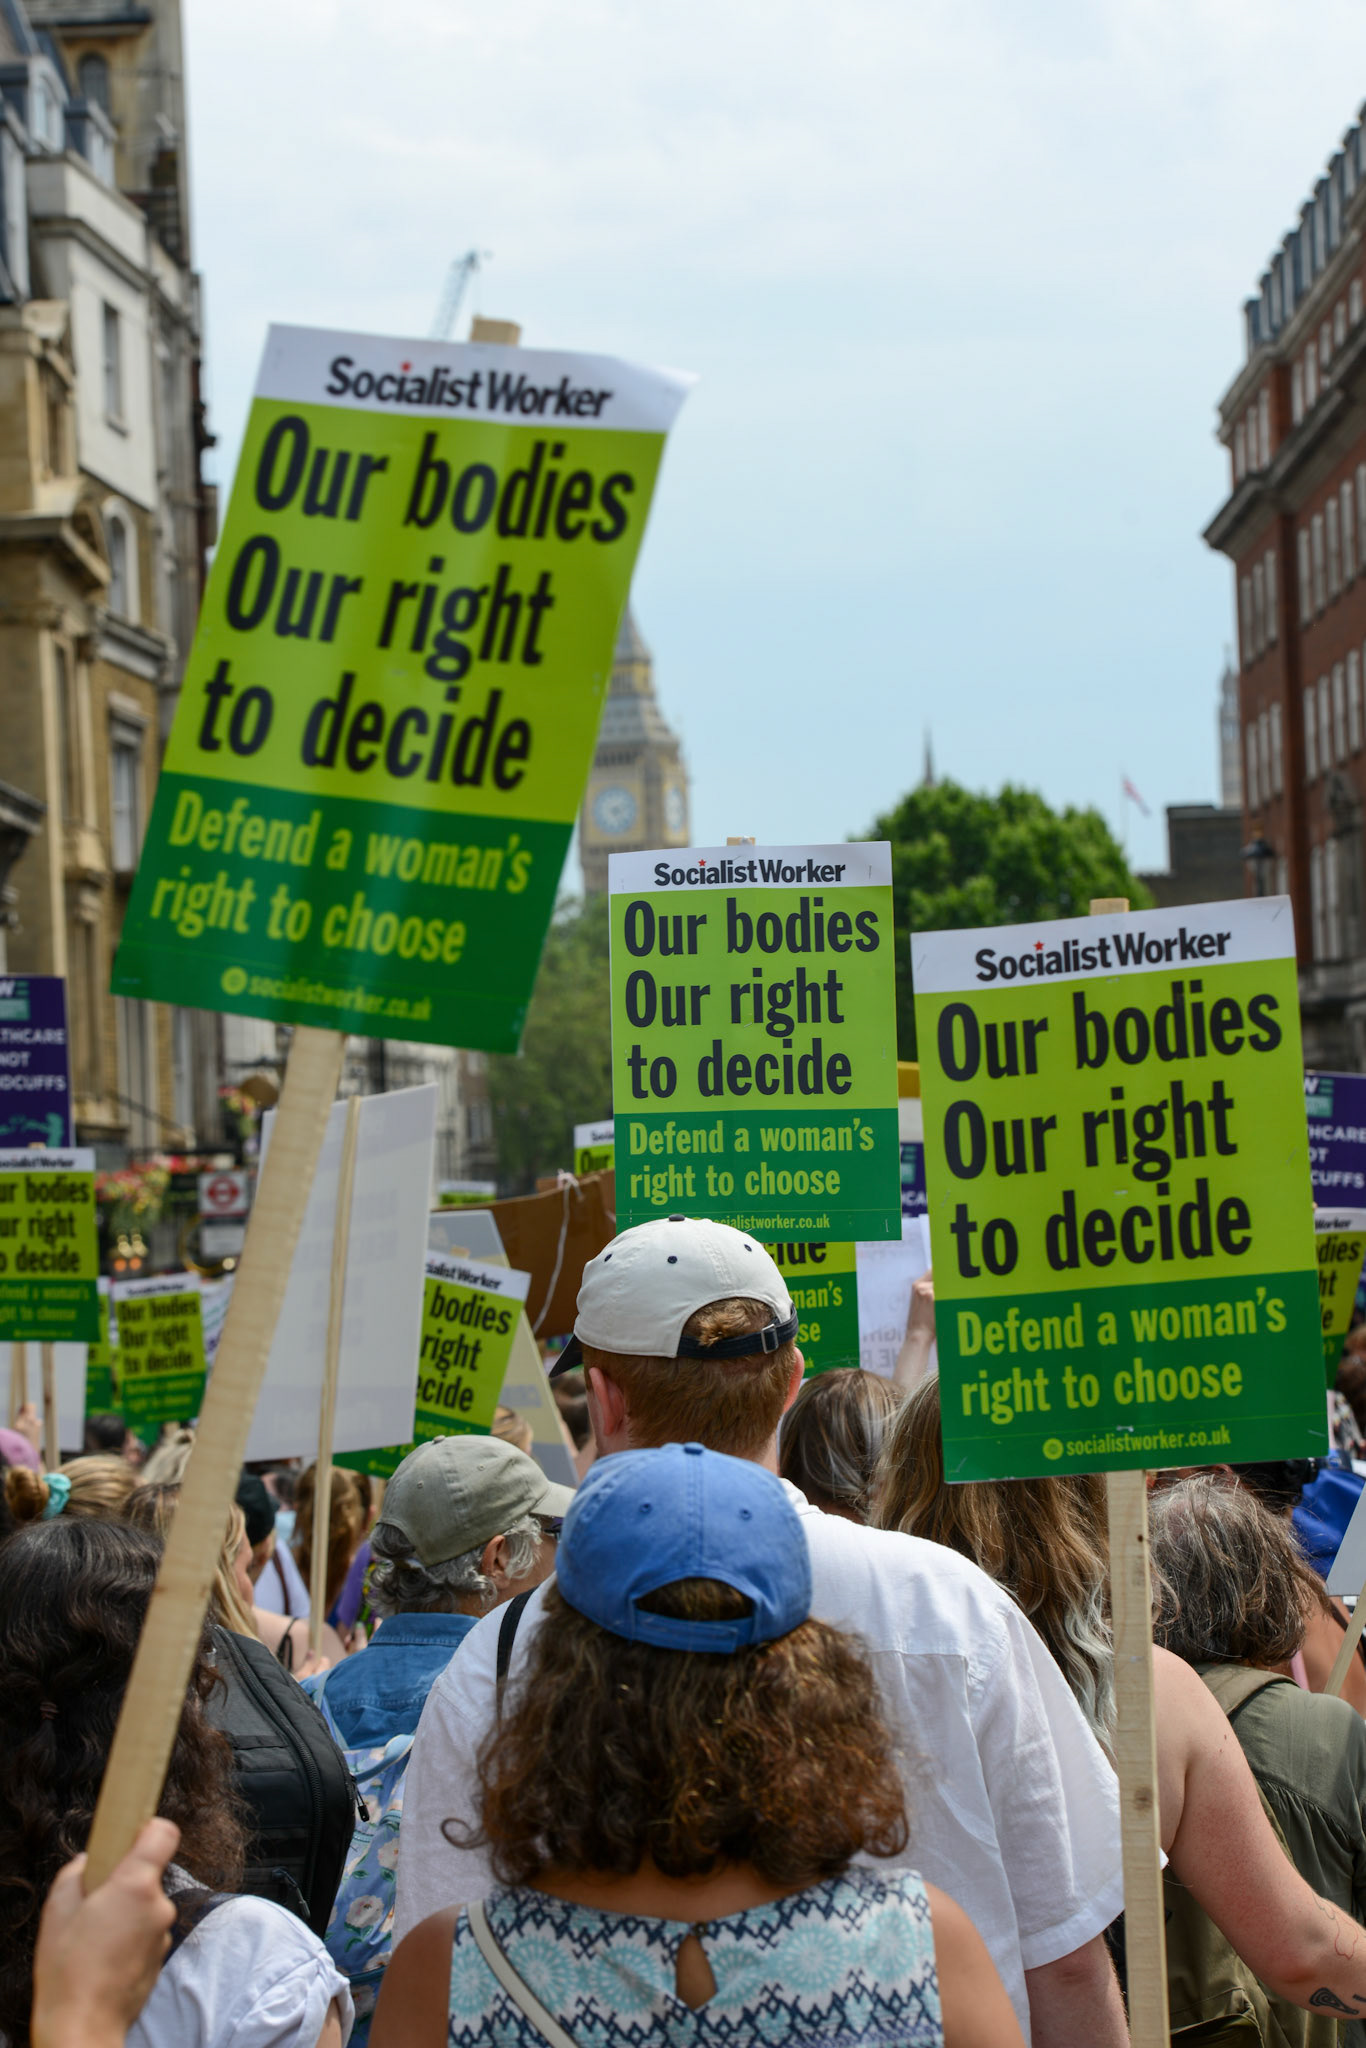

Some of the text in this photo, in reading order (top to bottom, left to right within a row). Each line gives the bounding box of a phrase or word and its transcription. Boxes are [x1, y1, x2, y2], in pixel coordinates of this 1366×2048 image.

[326, 356, 613, 417] Socialist Worker
[254, 415, 635, 543] Our bodies
[225, 535, 555, 681] Our right
[198, 660, 531, 791] to decide
[169, 790, 532, 893] Defend a woman's
[654, 859, 845, 886] Socialist Worker
[151, 866, 466, 964] right to choose
[624, 897, 880, 957] Our bodies
[975, 928, 1231, 982] Socialist Worker
[625, 967, 845, 1037] Our right
[0, 1028, 66, 1045] THCARE
[937, 979, 1282, 1082] Our bodies
[0, 1074, 66, 1091] DCUFFS
[627, 1037, 852, 1099] to decide
[629, 1118, 874, 1155] Defend a woman's
[943, 1080, 1238, 1182] Our right
[0, 1183, 18, 1204] ur
[630, 1162, 841, 1205] right to choose
[1311, 1169, 1365, 1189] CUFFS
[0, 1218, 20, 1238] ur
[713, 1213, 830, 1231] cialistworker.co.uk
[950, 1178, 1253, 1279] to decide
[1317, 1236, 1361, 1264] dies
[429, 1284, 512, 1335] bodies
[788, 1280, 843, 1309] man's
[957, 1302, 1085, 1356] Defend
[1098, 1311, 1118, 1345] a
[1131, 1287, 1287, 1343] woman's
[421, 1327, 481, 1372] right
[961, 1357, 1243, 1425] right to choose
[1066, 1424, 1231, 1456] socialistworker.co.uk
